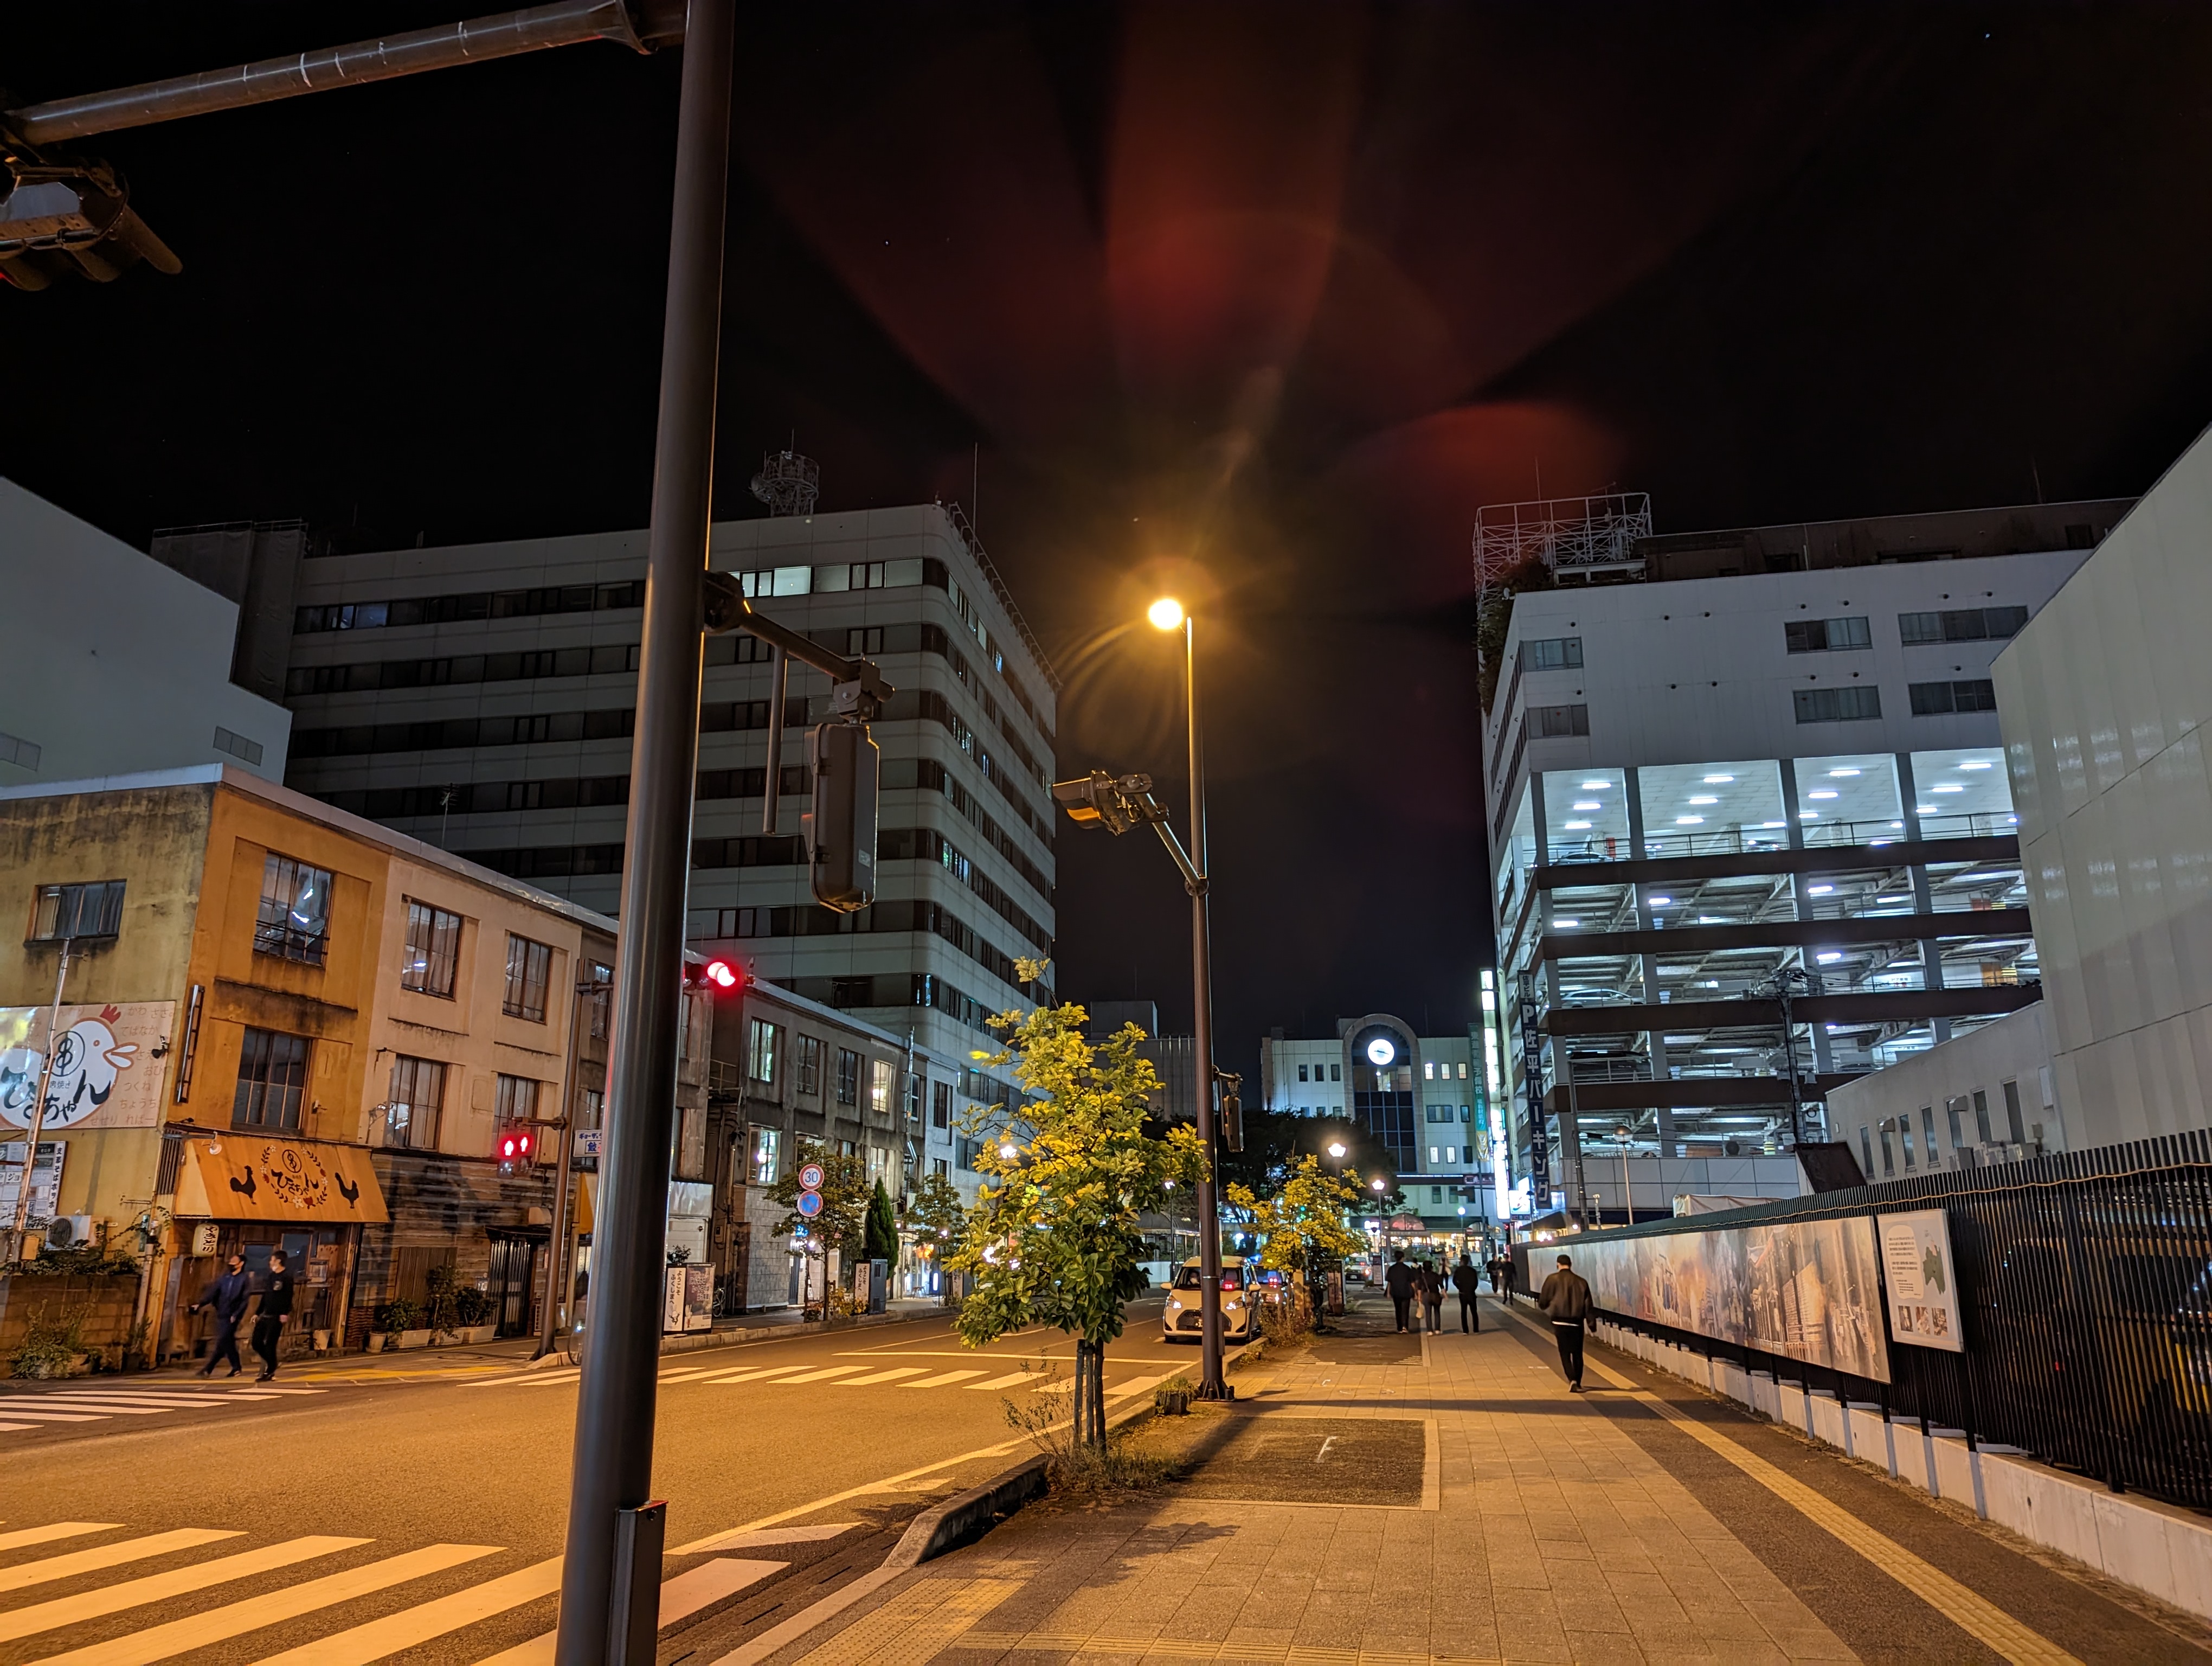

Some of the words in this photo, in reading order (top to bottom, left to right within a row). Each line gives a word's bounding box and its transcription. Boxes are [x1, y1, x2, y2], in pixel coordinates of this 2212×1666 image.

[124, 1081, 151, 1091] つくね
[90, 1114, 118, 1126] せせり
[126, 1113, 155, 1125] ればー
[805, 1171, 818, 1182] 30
[202, 1226, 217, 1253] やきとり
